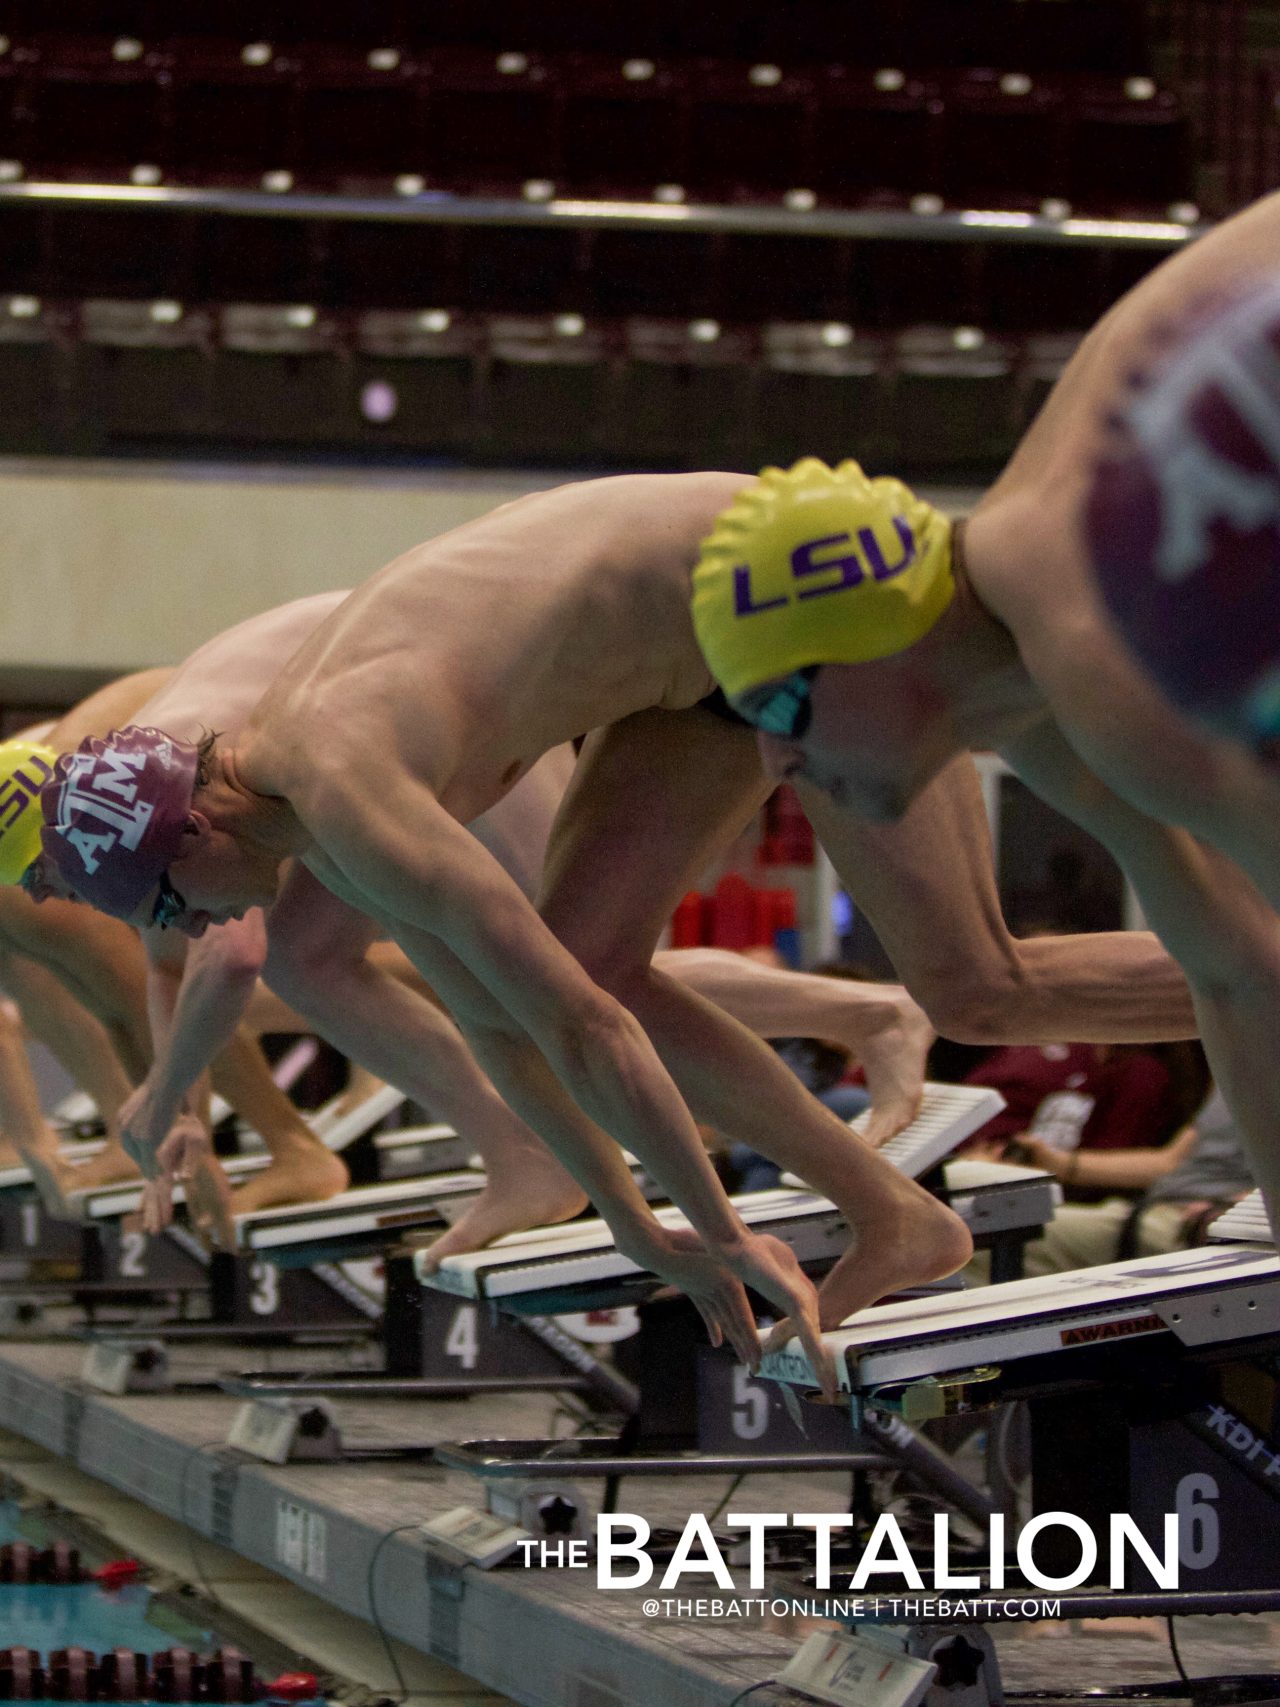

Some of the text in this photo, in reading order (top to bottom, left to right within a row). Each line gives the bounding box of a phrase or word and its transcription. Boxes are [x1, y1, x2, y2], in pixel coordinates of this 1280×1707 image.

[732, 514, 916, 620] LSU
[121, 1231, 147, 1278] 2
[250, 1261, 279, 1316] 3
[446, 1304, 478, 1369] 4
[732, 1364, 769, 1440] 5
[1176, 1472, 1220, 1570] 6
